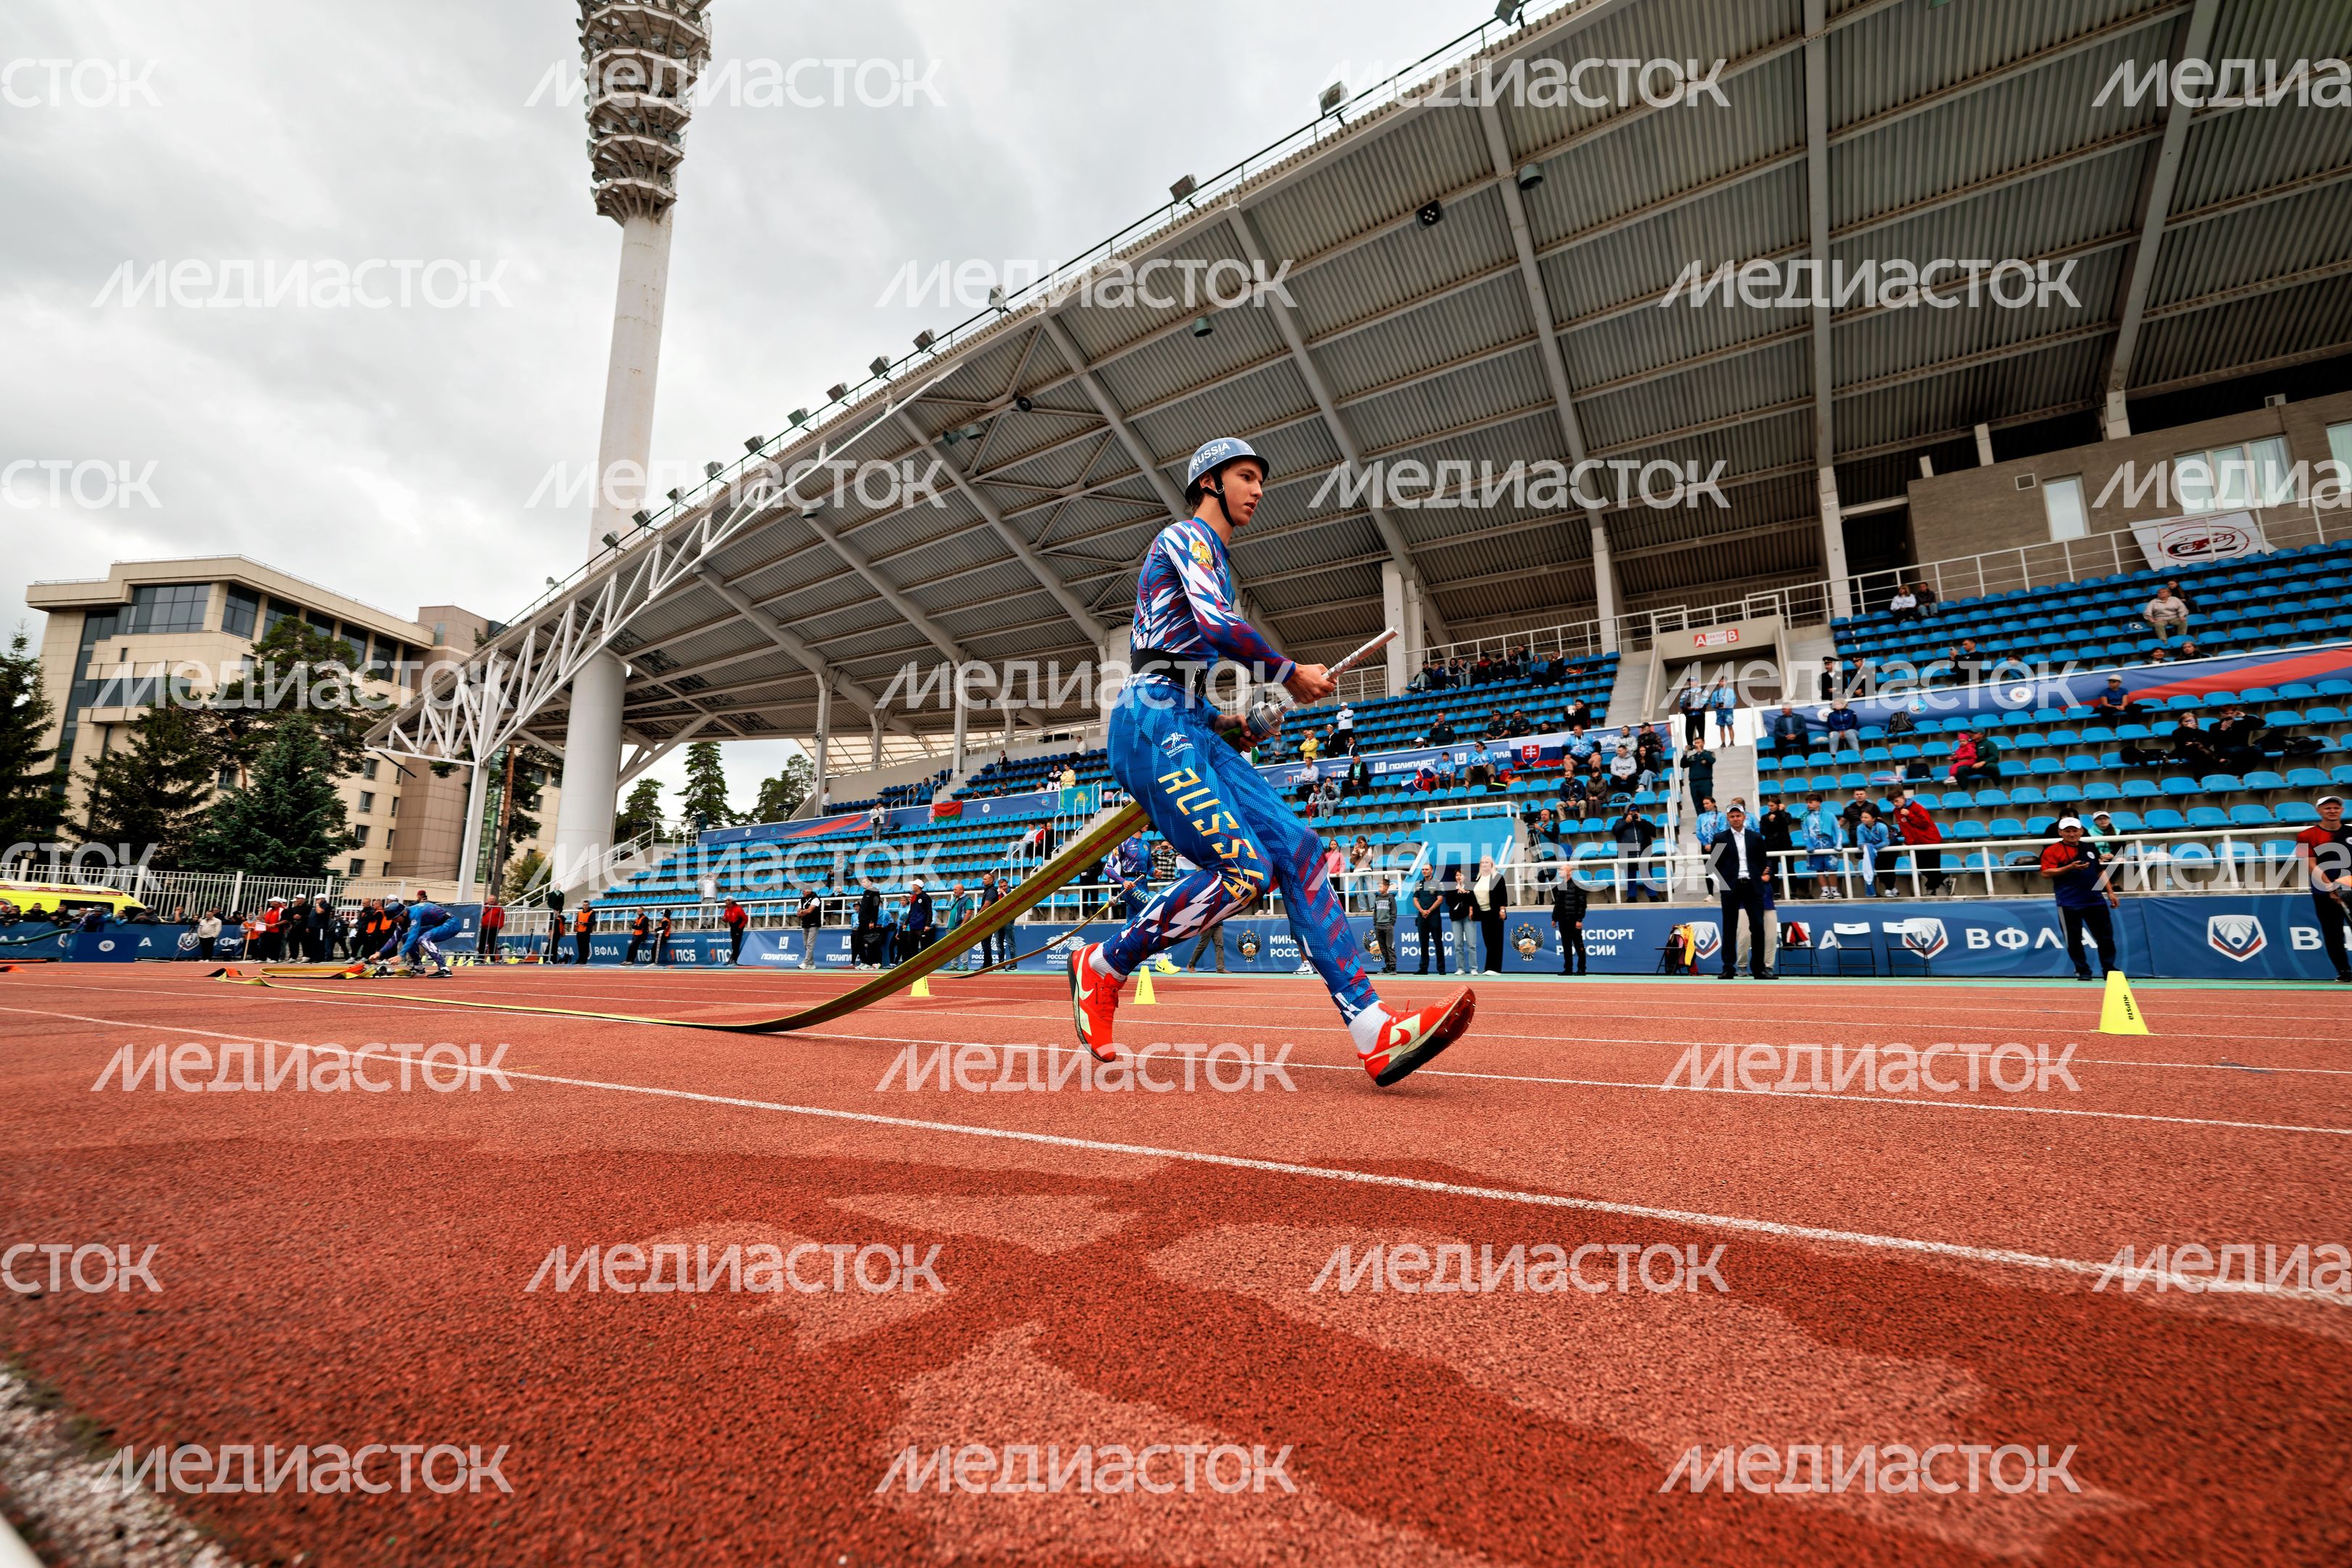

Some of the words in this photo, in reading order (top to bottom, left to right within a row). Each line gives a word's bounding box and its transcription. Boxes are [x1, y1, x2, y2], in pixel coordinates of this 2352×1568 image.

[1192, 442, 1230, 470] RUSSIA
[1389, 759, 1436, 769] ПОЛИПЛАСТ
[1157, 767, 1264, 906] RUSSIA
[595, 946, 619, 956] ВФЛА
[637, 950, 652, 962] ПС
[676, 949, 696, 962] ПСБ
